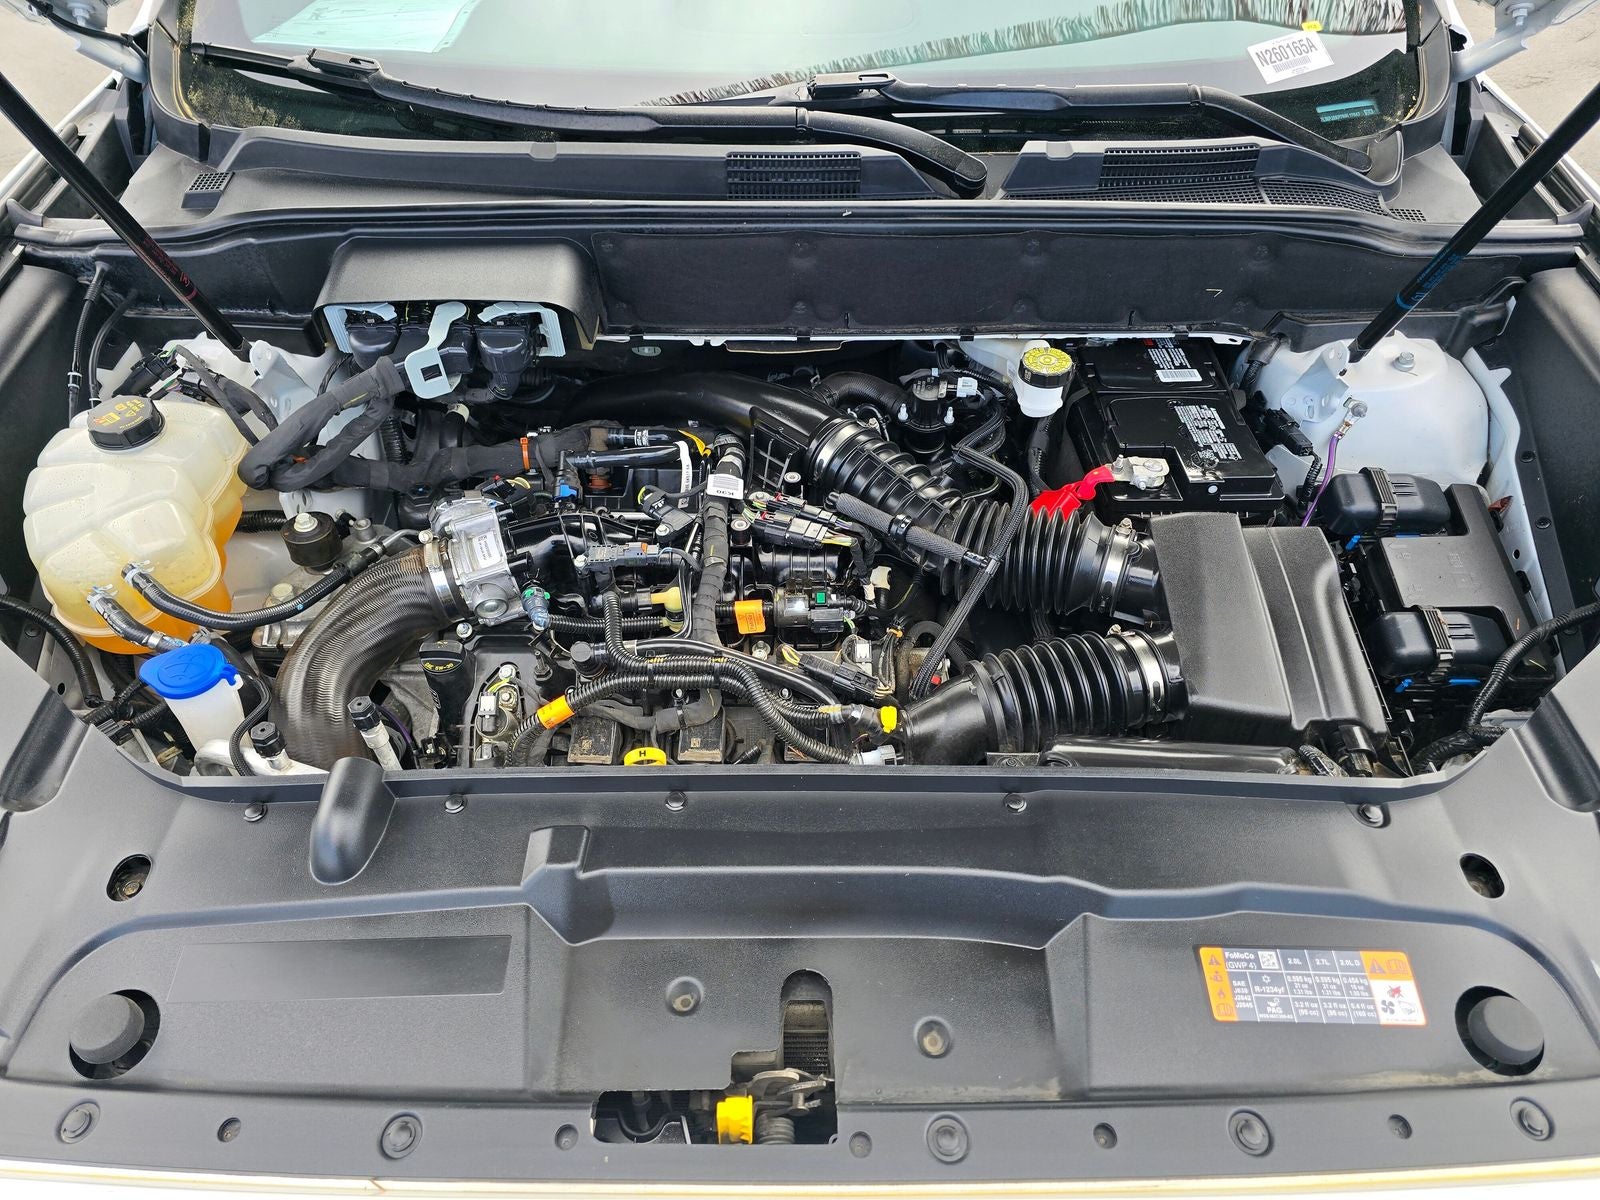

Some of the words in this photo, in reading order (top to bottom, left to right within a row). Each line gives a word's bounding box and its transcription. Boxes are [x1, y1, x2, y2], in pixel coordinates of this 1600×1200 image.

[1255, 37, 1318, 67] N260165A
[1226, 961, 1248, 970] (GWP
[1248, 962, 1257, 970] 4)
[1254, 985, 1285, 994] R-1234yf
